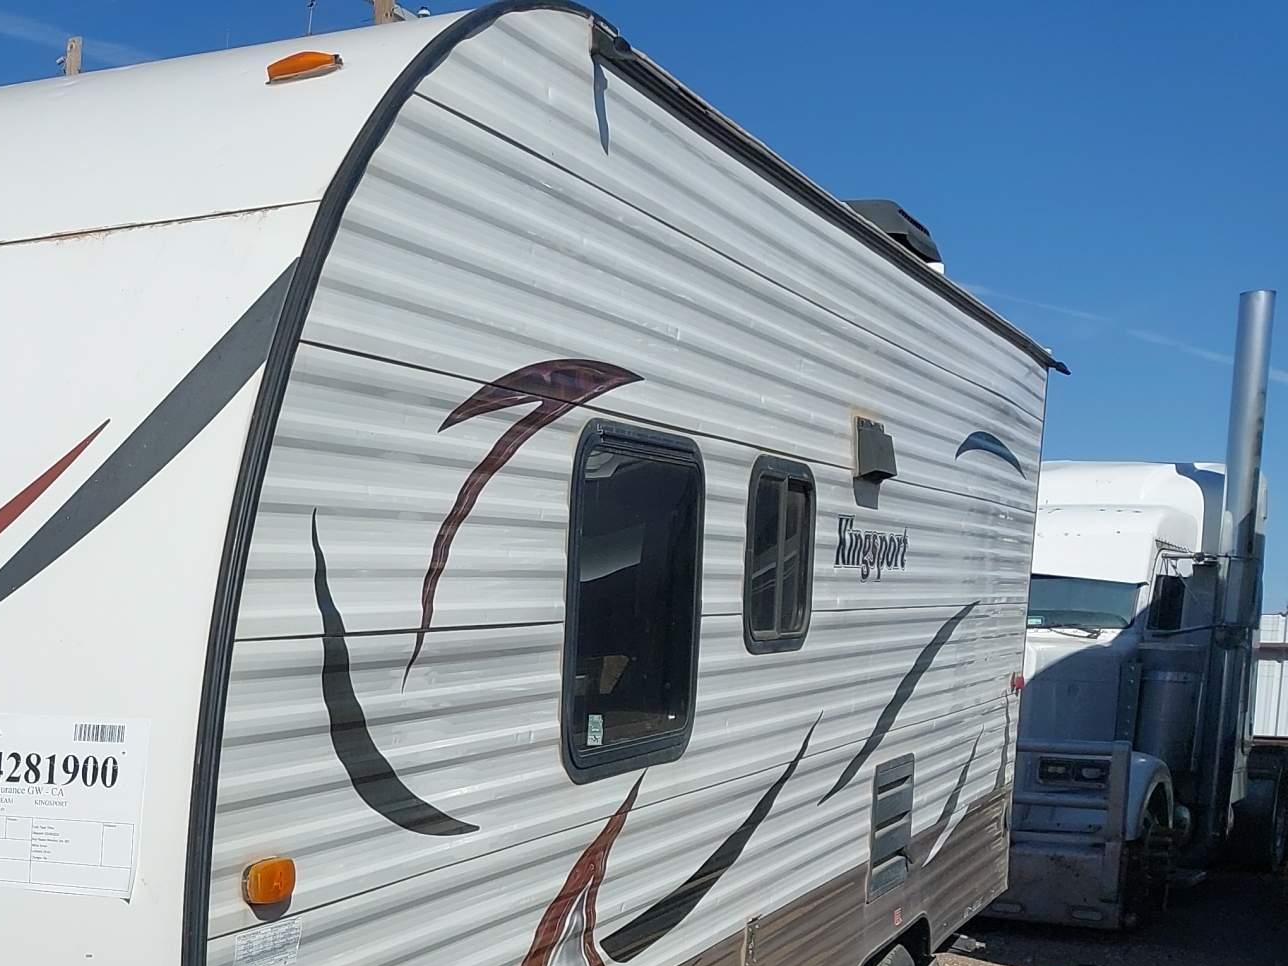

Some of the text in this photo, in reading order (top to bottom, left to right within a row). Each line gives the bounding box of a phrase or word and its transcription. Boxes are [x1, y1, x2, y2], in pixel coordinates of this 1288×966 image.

[834, 514, 909, 582] Kingsport
[27, 786, 44, 796] GW
[51, 787, 65, 798] CA
